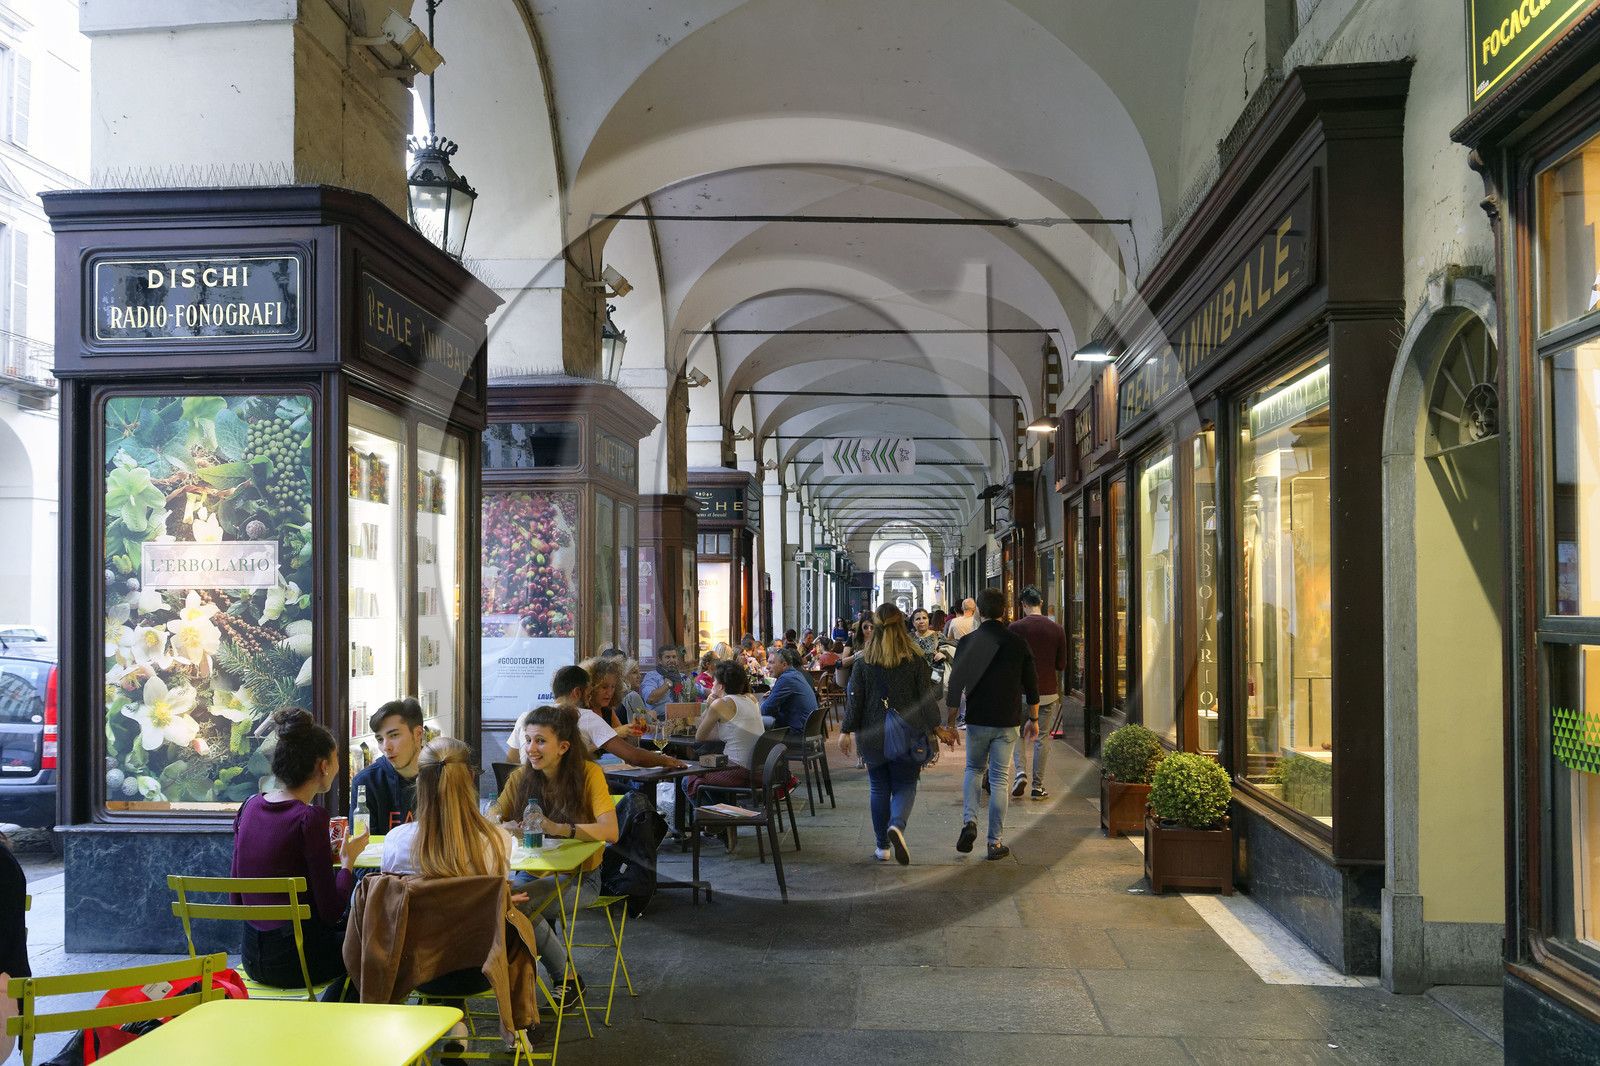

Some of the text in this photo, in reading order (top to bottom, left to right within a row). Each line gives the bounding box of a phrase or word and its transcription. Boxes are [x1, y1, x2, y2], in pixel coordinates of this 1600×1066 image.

[147, 266, 249, 289] DISCHI
[110, 302, 283, 329] RADIO-FONOGRAFI
[1125, 215, 1292, 423] REALE ANNIBALE
[367, 287, 474, 380] REALE ANNIBALE
[150, 558, 270, 572] L'ERBOLARIO
[497, 657, 545, 665] #GOODTOEARTH
